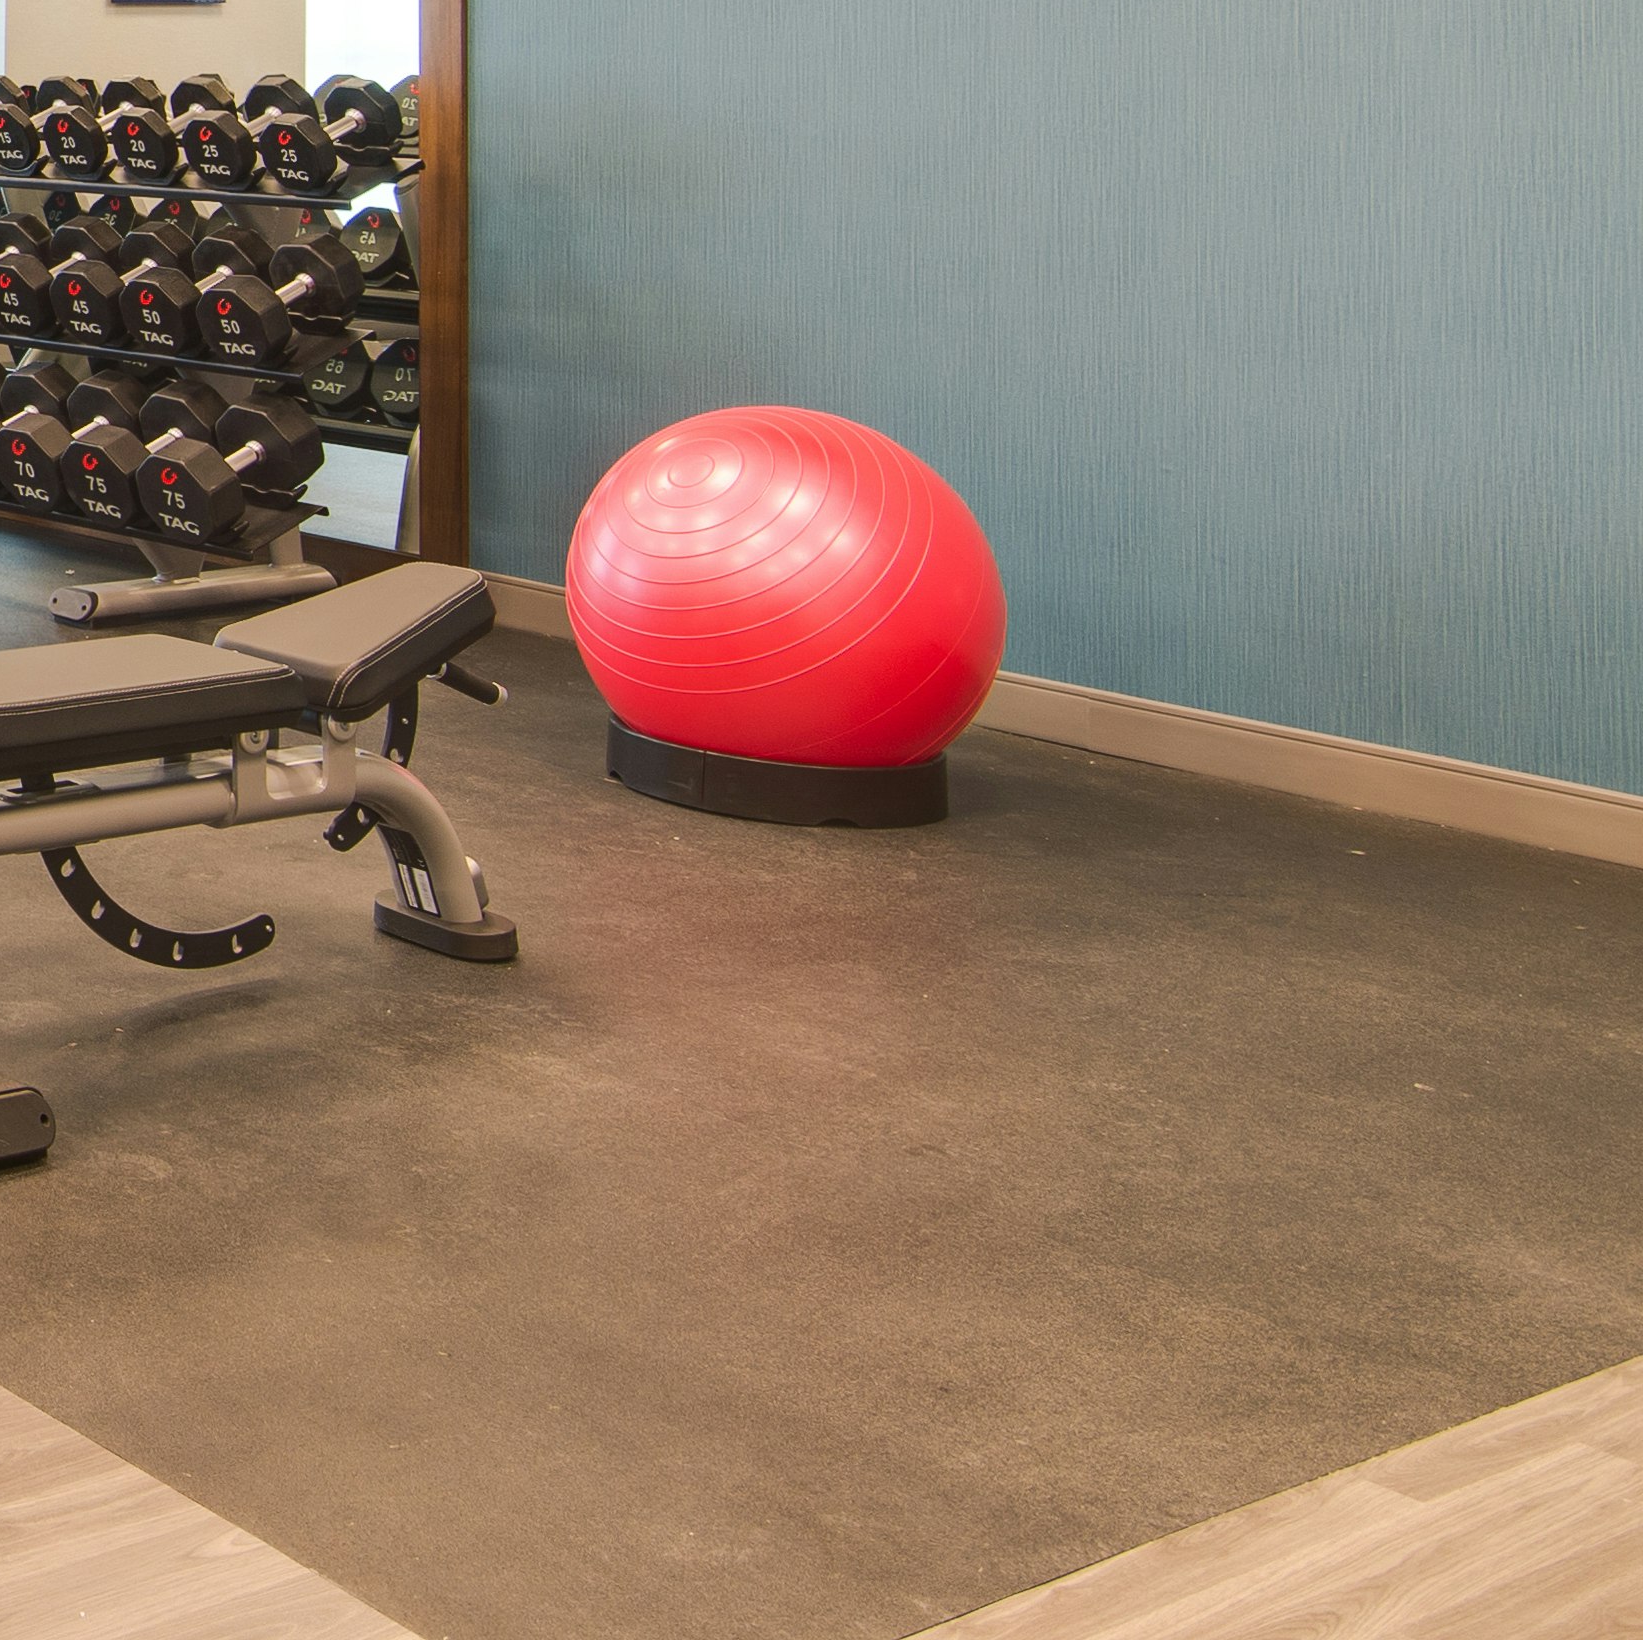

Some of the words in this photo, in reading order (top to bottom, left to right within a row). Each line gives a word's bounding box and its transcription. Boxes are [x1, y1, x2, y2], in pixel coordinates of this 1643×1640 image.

[0, 132, 11, 143] 15
[61, 137, 75, 148] 20
[130, 140, 145, 152] 20
[203, 145, 218, 157] 25
[60, 155, 87, 164] TAG
[281, 149, 297, 162] 25
[128, 158, 156, 169] TAG
[200, 164, 230, 175] TAG
[278, 168, 309, 181] TAG
[4, 292, 18, 306] 45
[73, 300, 89, 314] 45
[1, 312, 31, 326] TAG
[143, 309, 160, 324] 50
[70, 321, 101, 334] TAG
[221, 320, 240, 334] 50
[140, 331, 173, 346] TAG
[220, 342, 255, 355] TAG
[15, 461, 34, 477] 70
[85, 475, 106, 493] 75
[14, 484, 49, 502] TAG
[163, 490, 185, 509] 75
[84, 499, 121, 518] TAG
[159, 513, 199, 535] TAG
